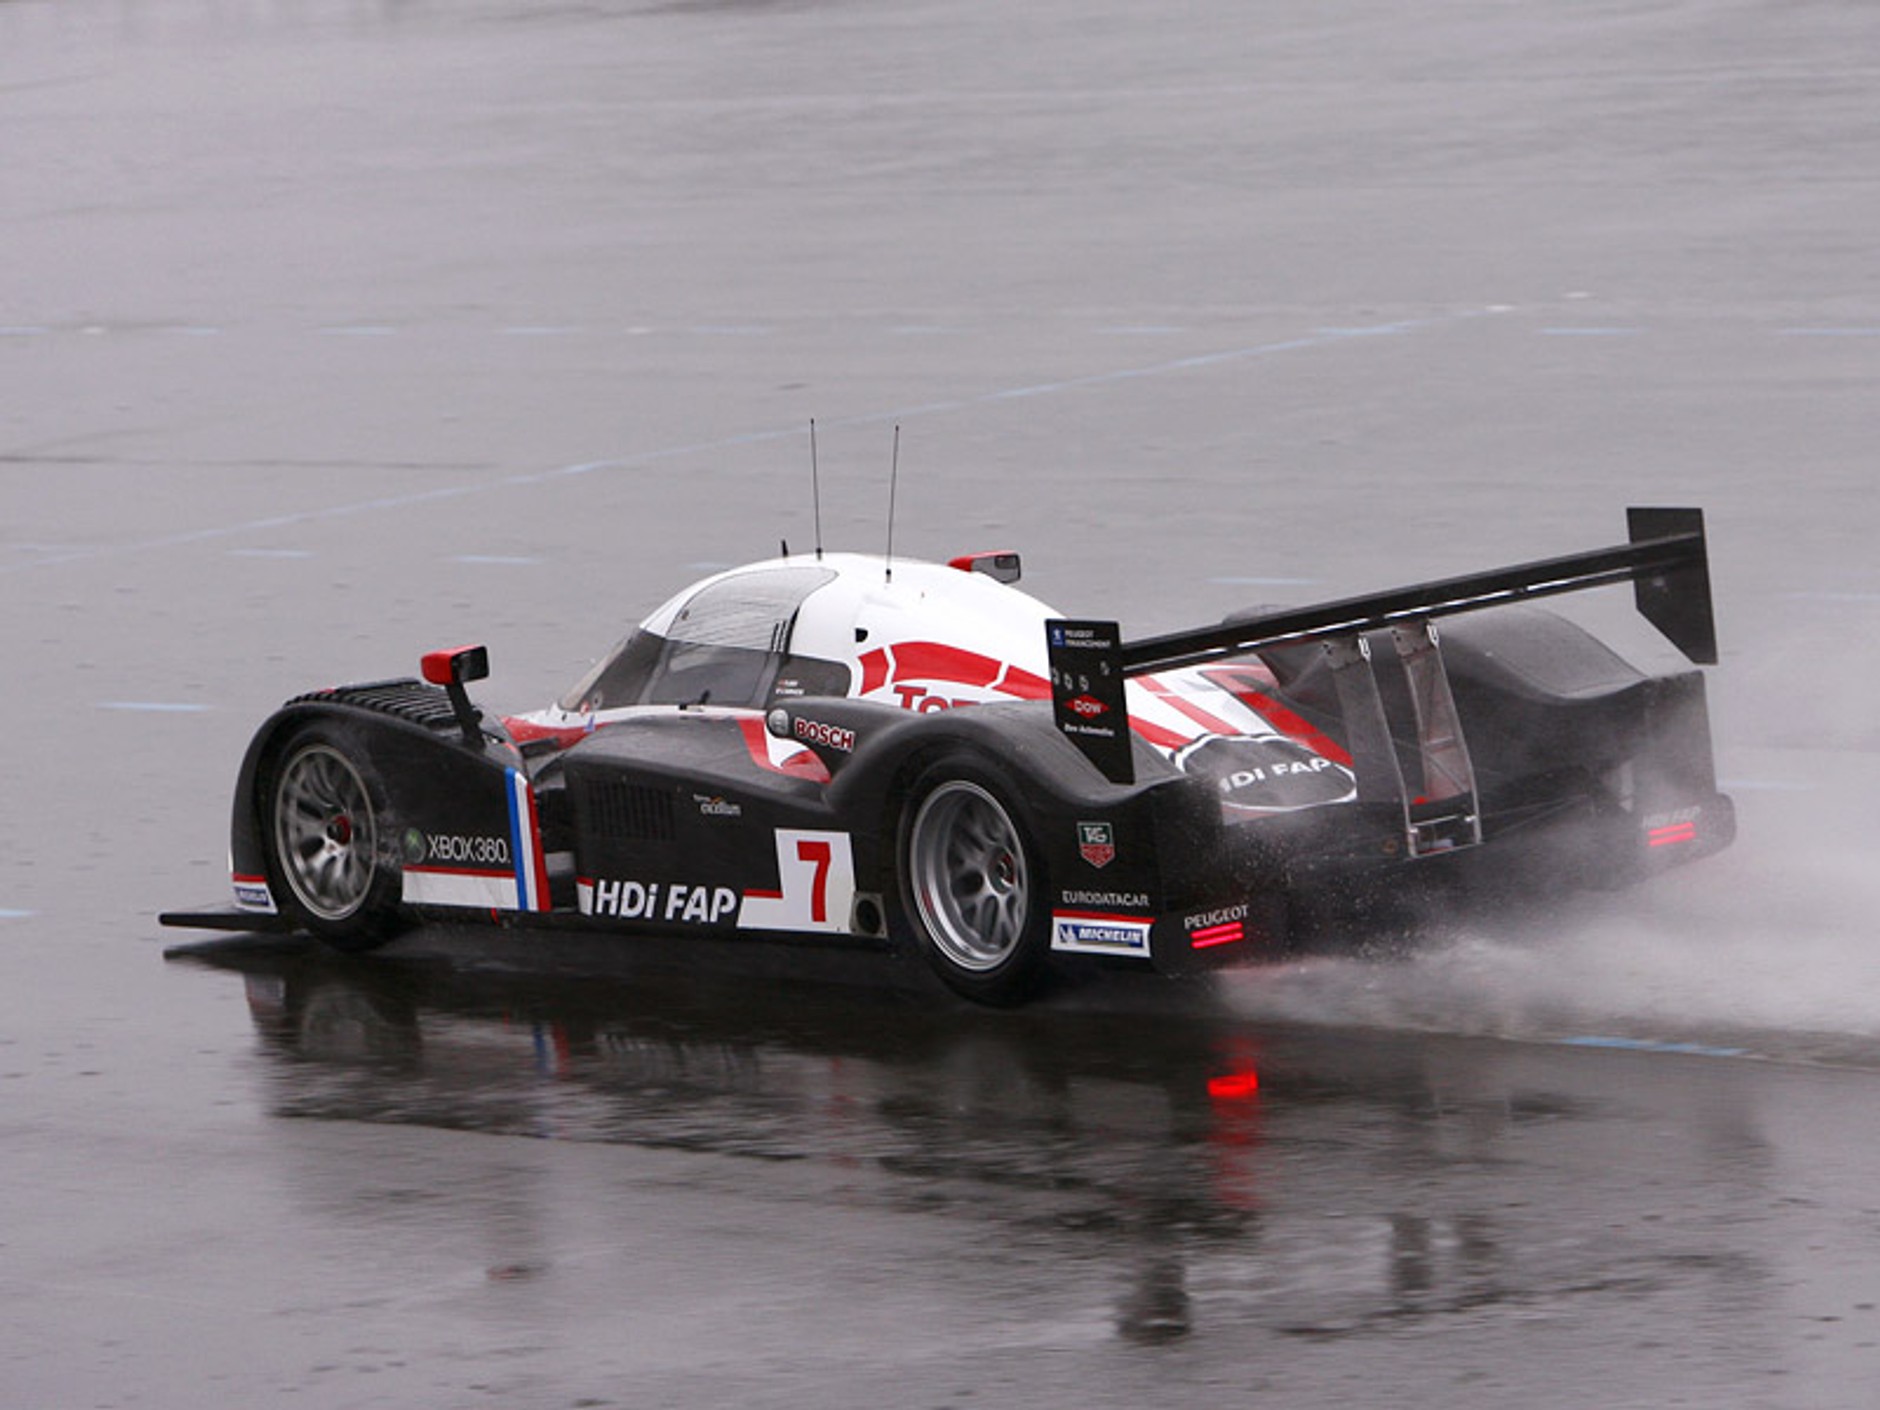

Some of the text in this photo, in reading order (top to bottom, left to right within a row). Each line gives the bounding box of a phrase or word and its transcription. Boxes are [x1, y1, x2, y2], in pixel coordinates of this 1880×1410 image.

[794, 717, 855, 751] BOSCH
[1271, 756, 1332, 776] FAP
[797, 841, 831, 921] 7
[596, 880, 736, 923] HDi FAP
[1184, 905, 1249, 930] PEUGEOT
[1078, 926, 1143, 944] MICHELIN
